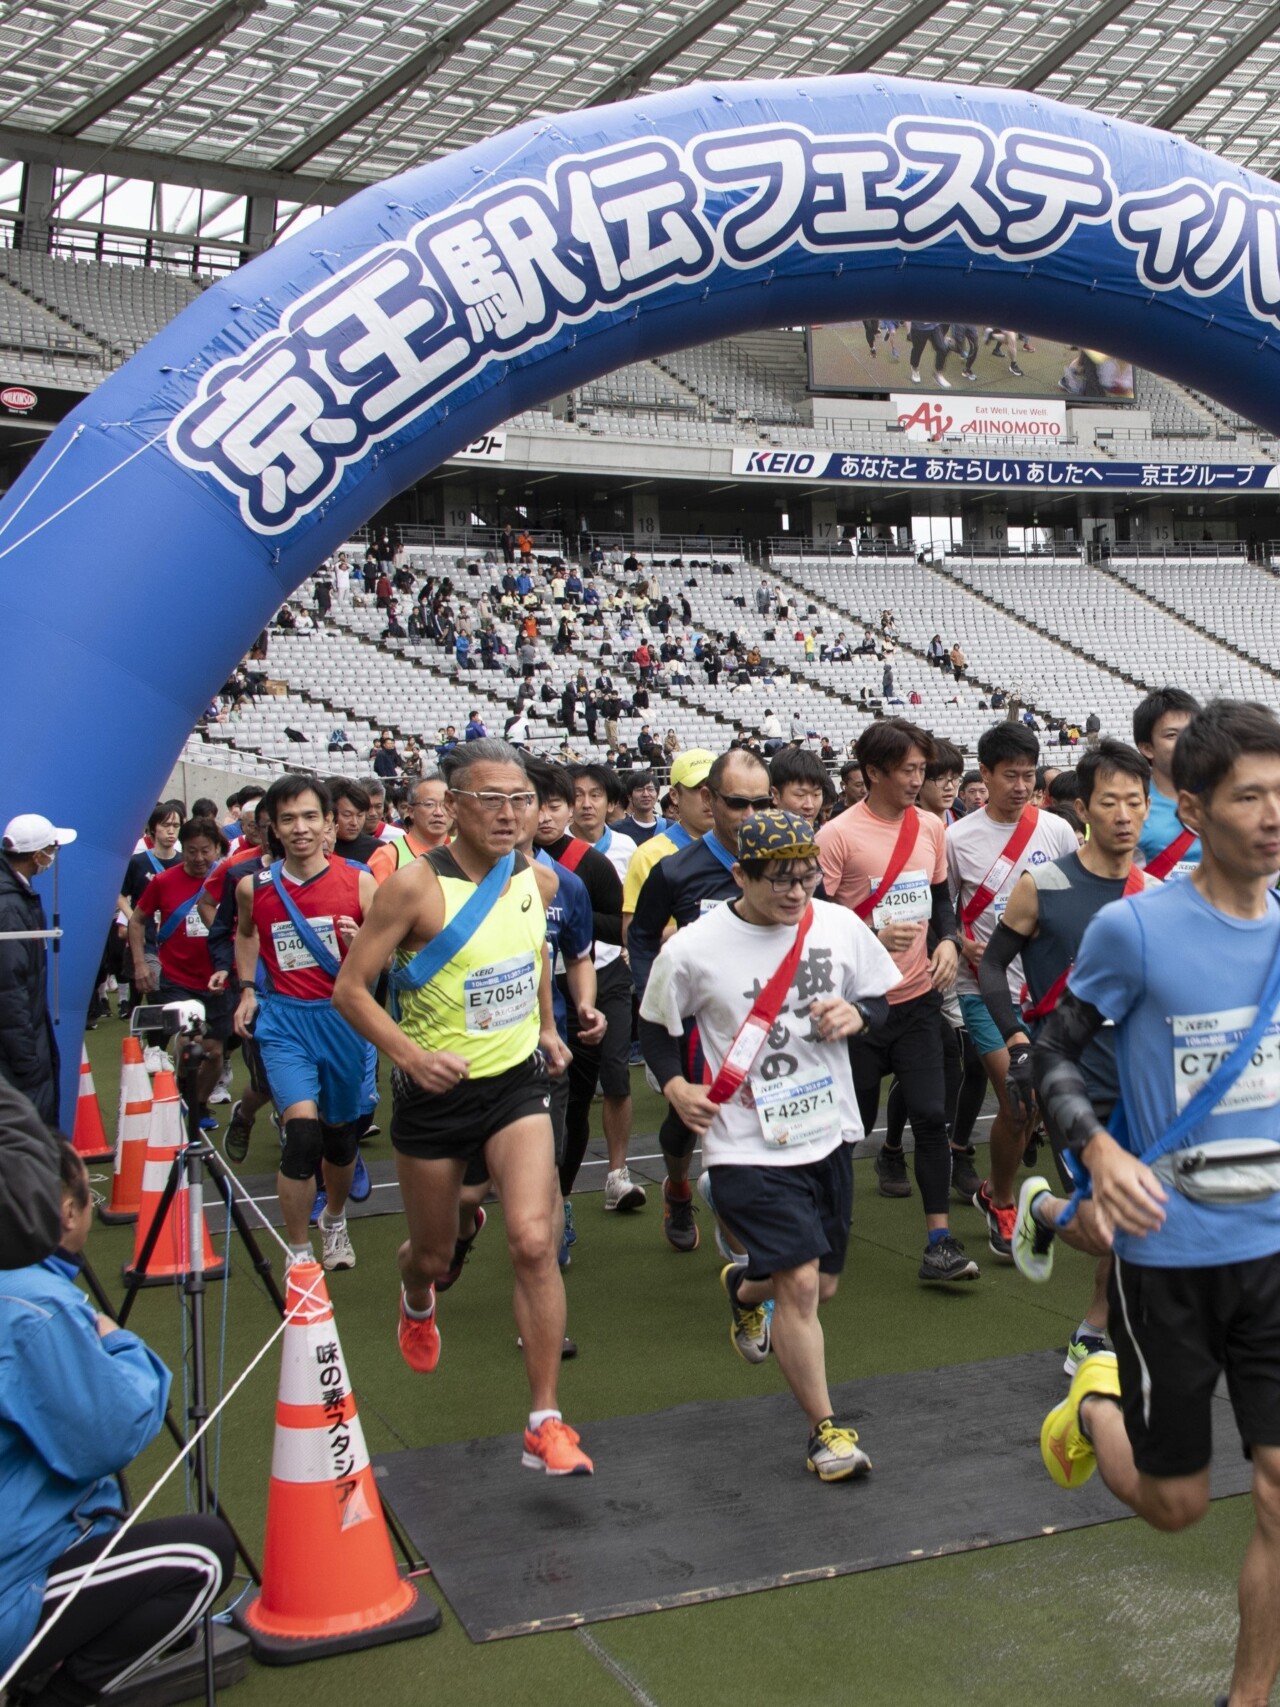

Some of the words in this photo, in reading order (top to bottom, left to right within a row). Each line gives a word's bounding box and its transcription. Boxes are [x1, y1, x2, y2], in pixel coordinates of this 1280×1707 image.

[975, 406, 988, 414] Eat
[1011, 407, 1028, 415] Live
[960, 419, 1061, 436] AJINOMOTO
[746, 452, 815, 474] KEIO
[841, 456, 918, 480] あなたと
[925, 459, 1020, 482] あたらしい
[450, 511, 467, 526] 19
[639, 517, 655, 533] 18
[817, 523, 832, 537] 17
[989, 525, 1003, 540] 16
[1155, 526, 1169, 540] 15
[277, 933, 333, 952] D40-1
